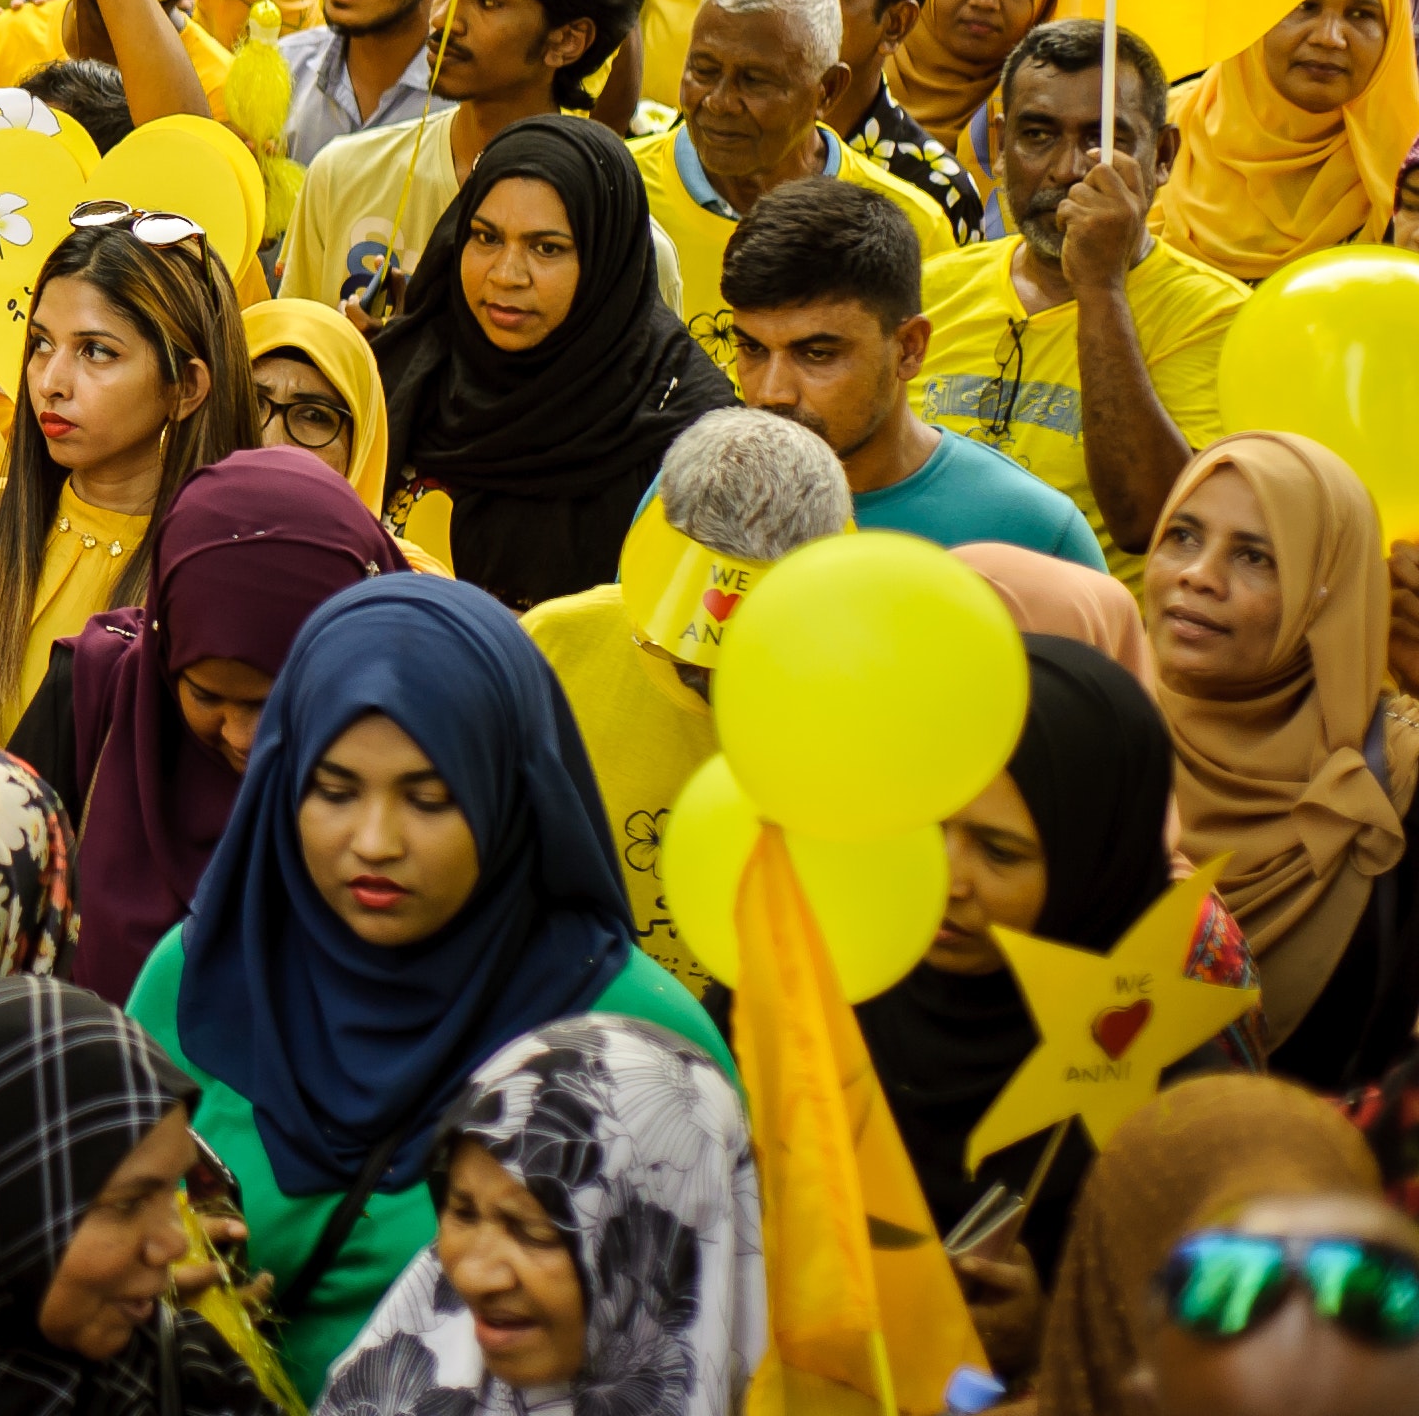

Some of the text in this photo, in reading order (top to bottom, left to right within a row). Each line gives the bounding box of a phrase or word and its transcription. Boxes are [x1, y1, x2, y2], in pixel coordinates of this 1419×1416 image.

[711, 564, 751, 592] WE
[677, 620, 725, 647] AN
[1112, 972, 1155, 996] WE
[1064, 1061, 1133, 1084] ANNI
